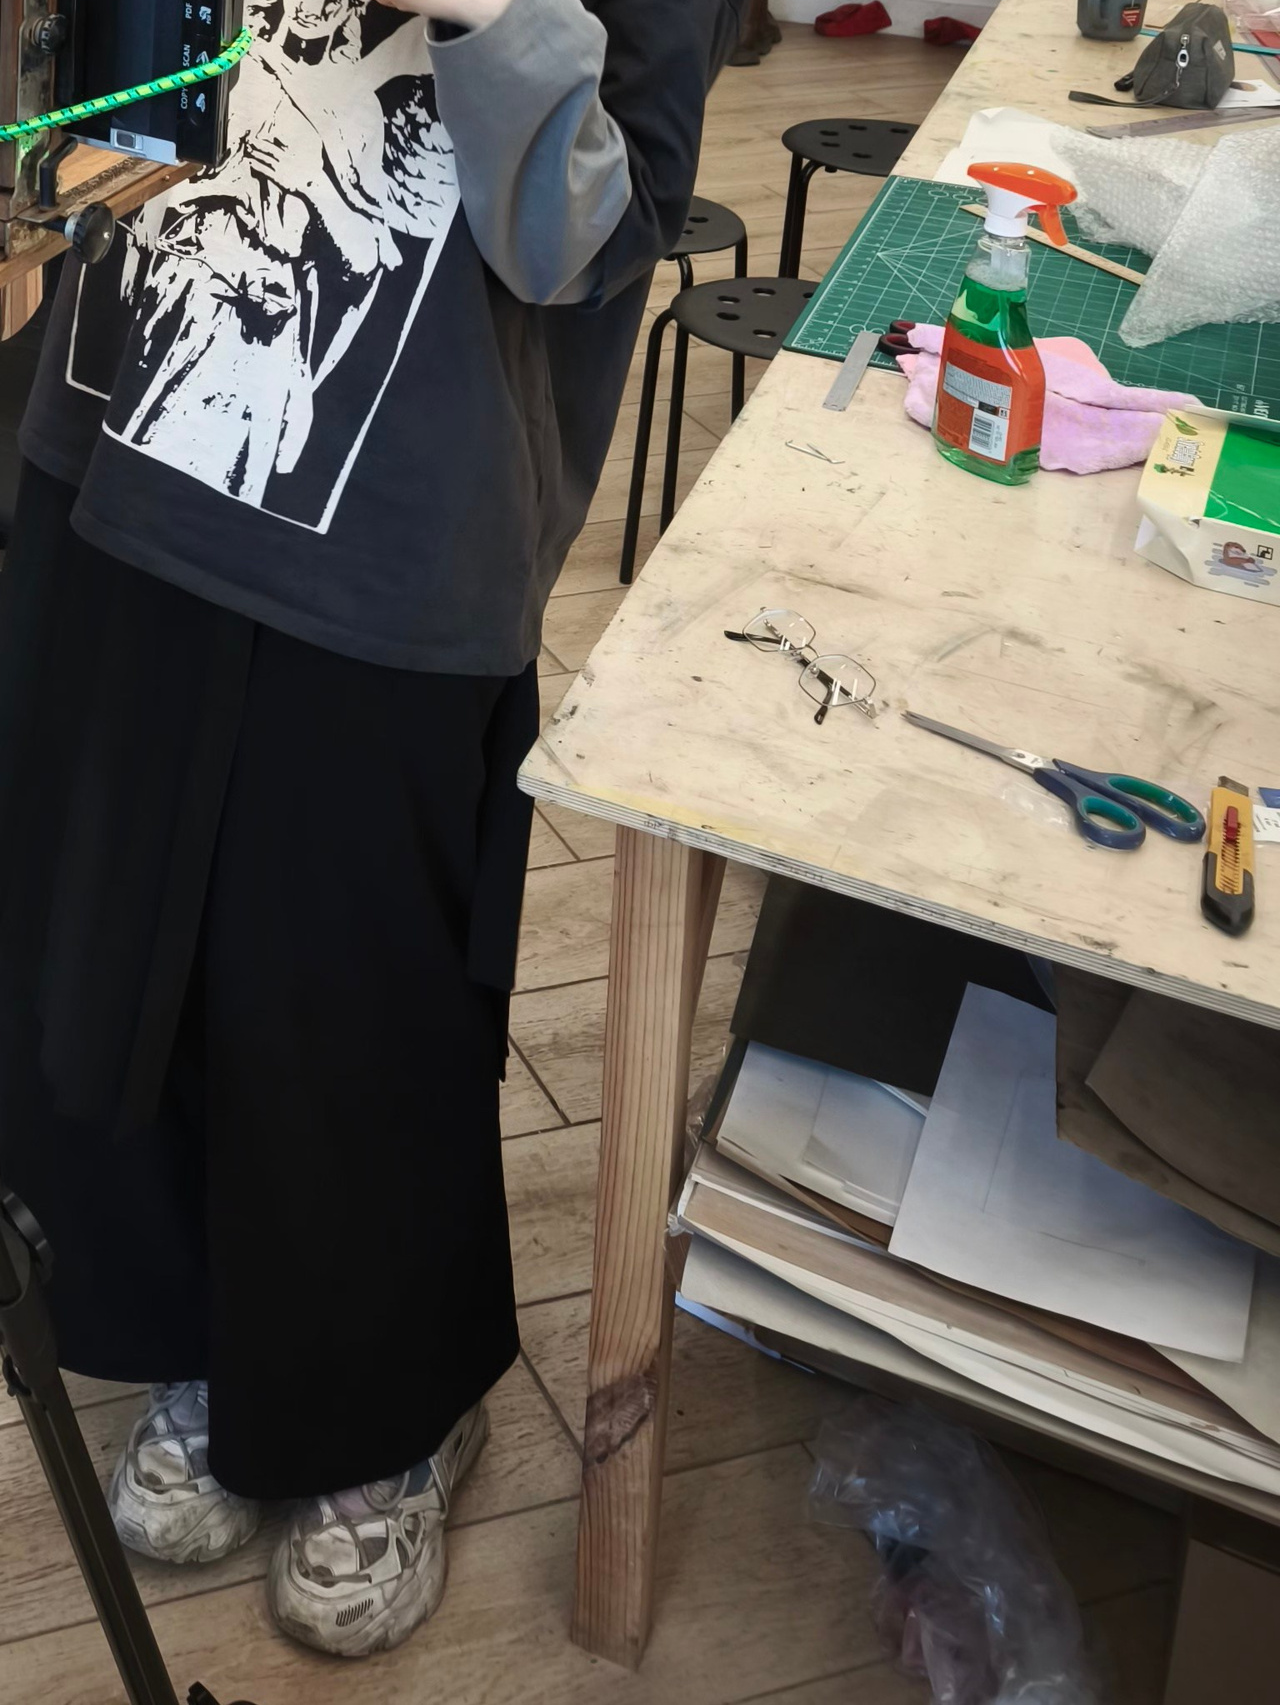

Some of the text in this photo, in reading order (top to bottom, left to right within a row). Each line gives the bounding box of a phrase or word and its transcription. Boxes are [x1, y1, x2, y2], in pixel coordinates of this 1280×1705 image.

[184, 2, 192, 19] PDF
[183, 43, 191, 67] SCAN
[180, 83, 189, 109] COPY
